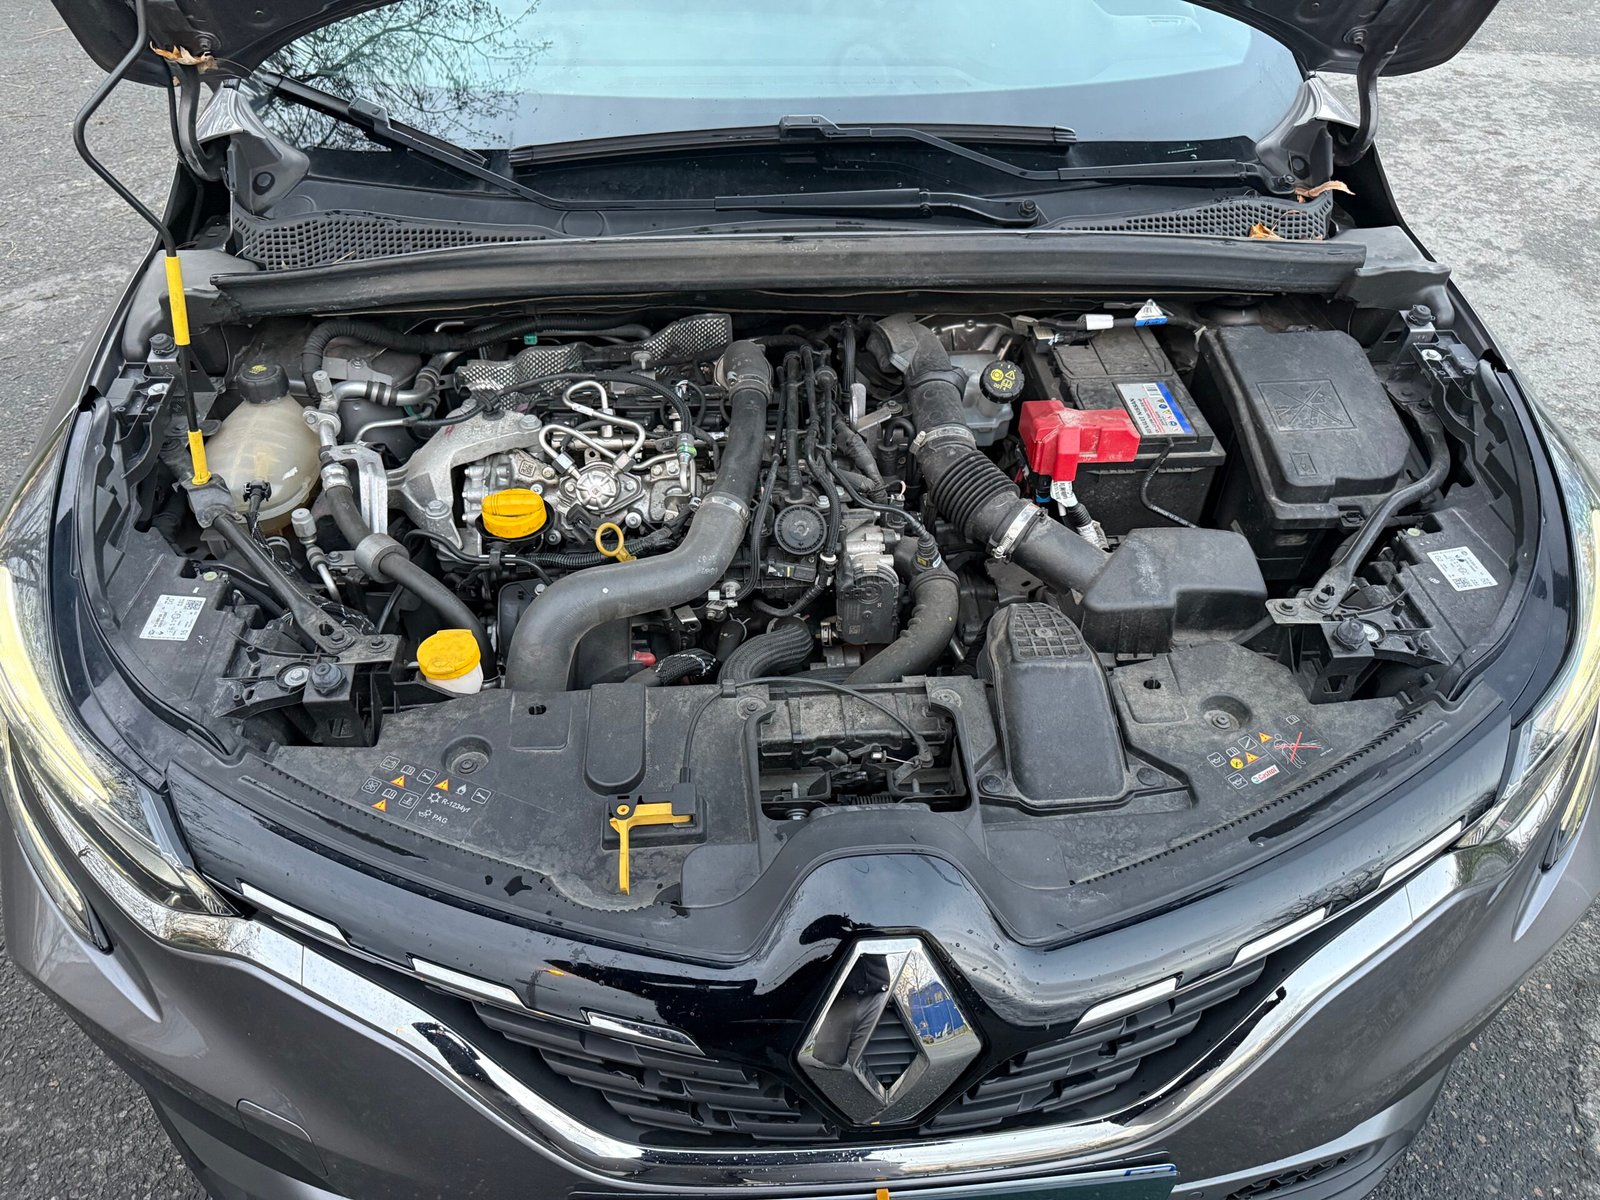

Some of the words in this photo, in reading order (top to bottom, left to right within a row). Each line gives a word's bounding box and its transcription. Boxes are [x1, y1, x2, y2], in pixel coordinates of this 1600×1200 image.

[1258, 767, 1278, 780] Castrol
[441, 798, 471, 813] R-1234yf
[432, 814, 448, 824] PAG
